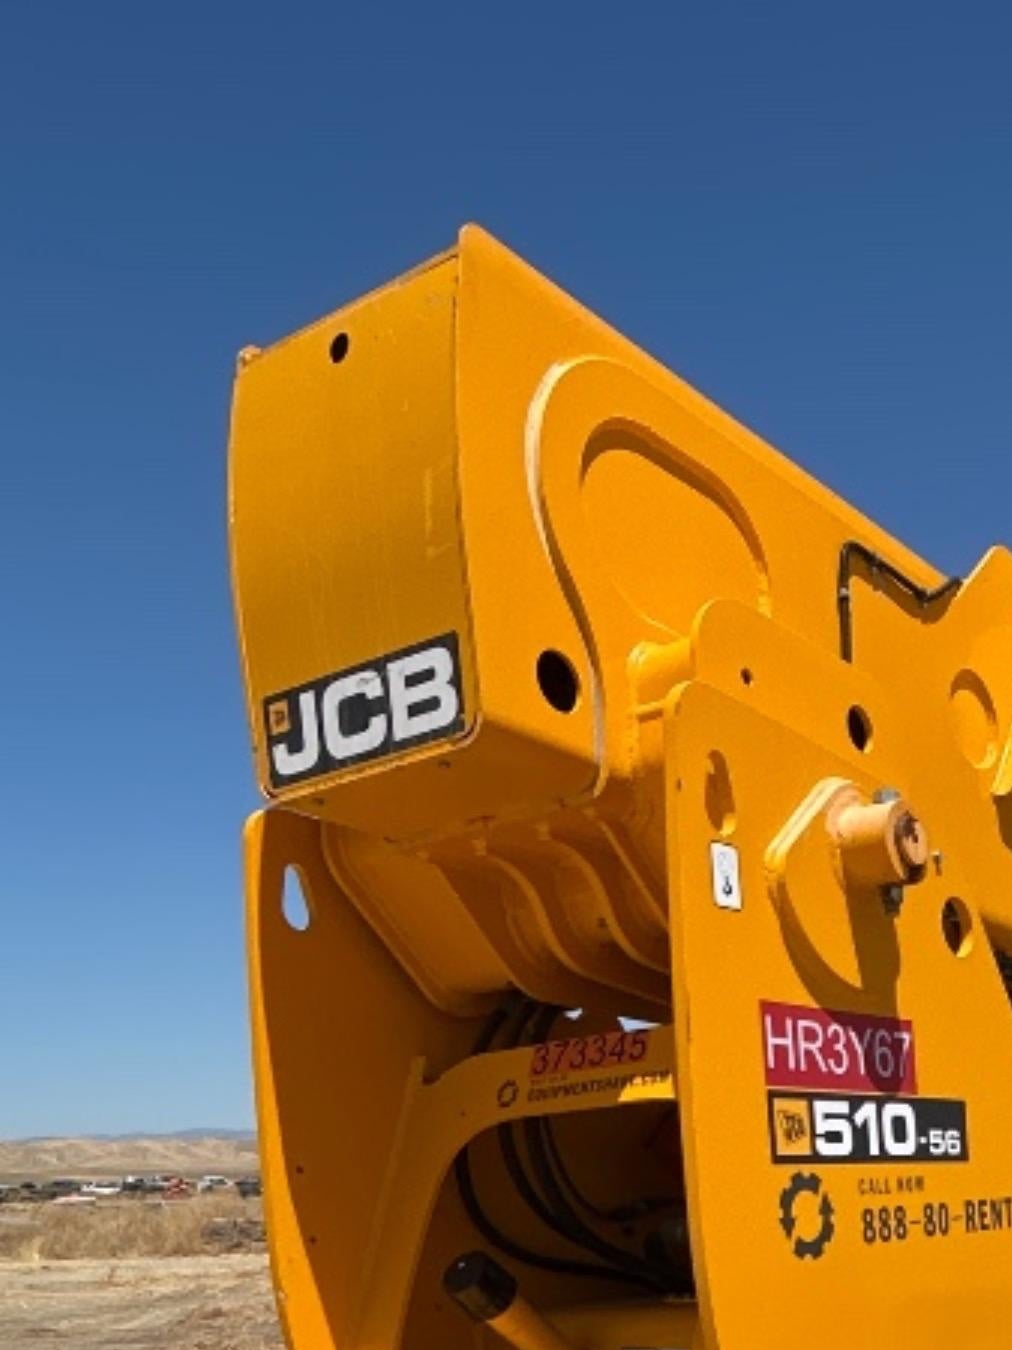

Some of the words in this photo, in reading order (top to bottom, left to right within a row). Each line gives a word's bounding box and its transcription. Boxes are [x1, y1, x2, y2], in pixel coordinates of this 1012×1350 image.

[271, 646, 460, 777] JCB
[530, 1031, 648, 1076] 373345
[763, 1012, 913, 1079] HR3Y67
[857, 1177, 892, 1195] CALL
